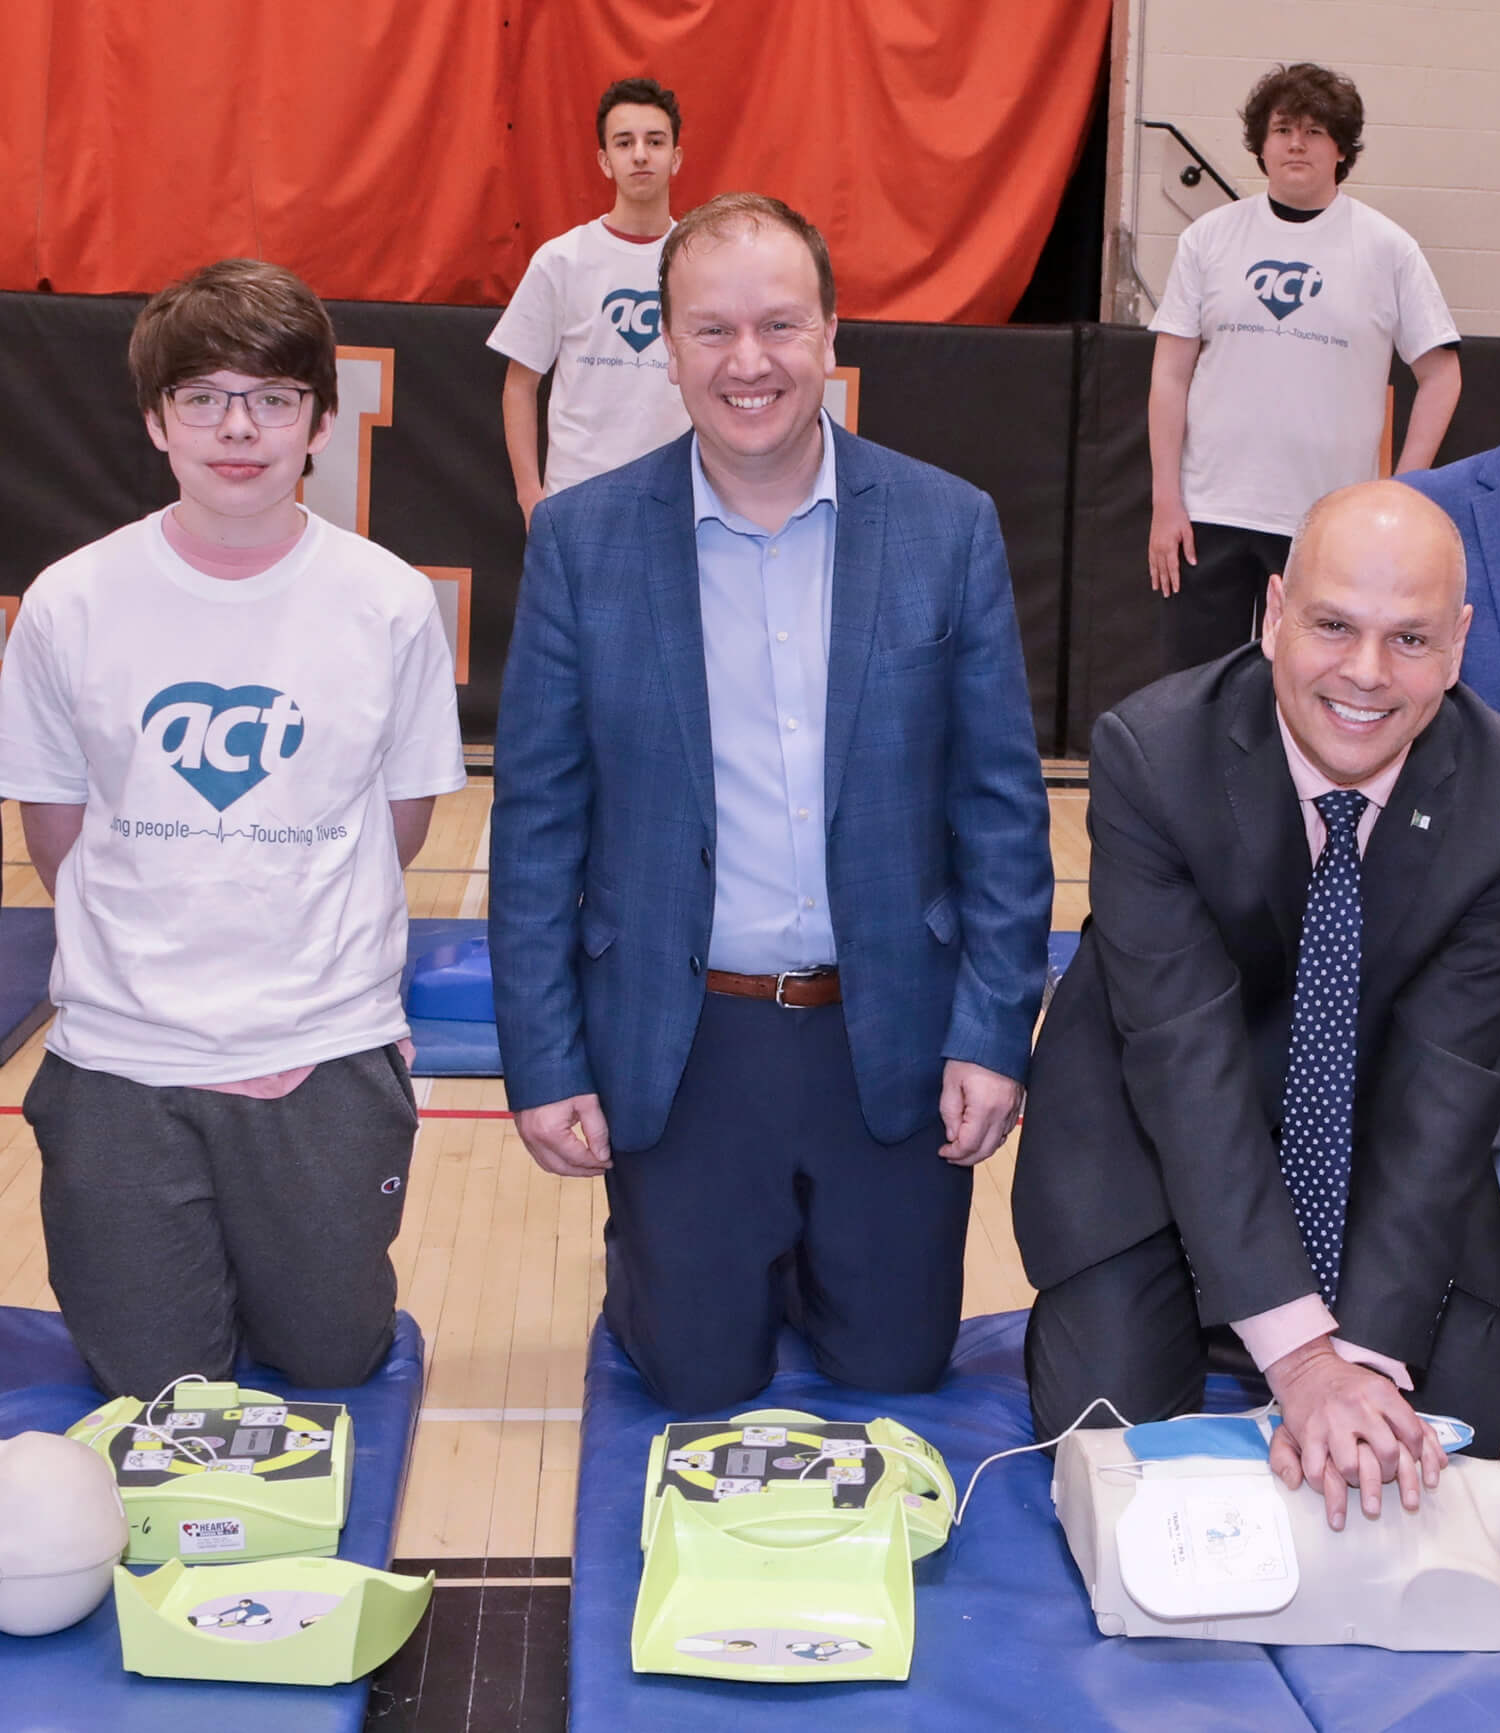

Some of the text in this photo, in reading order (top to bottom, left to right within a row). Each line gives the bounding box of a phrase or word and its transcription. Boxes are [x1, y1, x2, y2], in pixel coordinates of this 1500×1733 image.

[1246, 266, 1323, 303] act
[602, 298, 661, 334] ac
[1237, 323, 1264, 334] people
[1293, 328, 1328, 344] Touching
[1330, 335, 1349, 348] lives
[597, 356, 623, 368] people
[143, 694, 303, 772] act
[136, 820, 190, 841] people
[250, 824, 313, 846] Touching
[316, 825, 348, 841] lives
